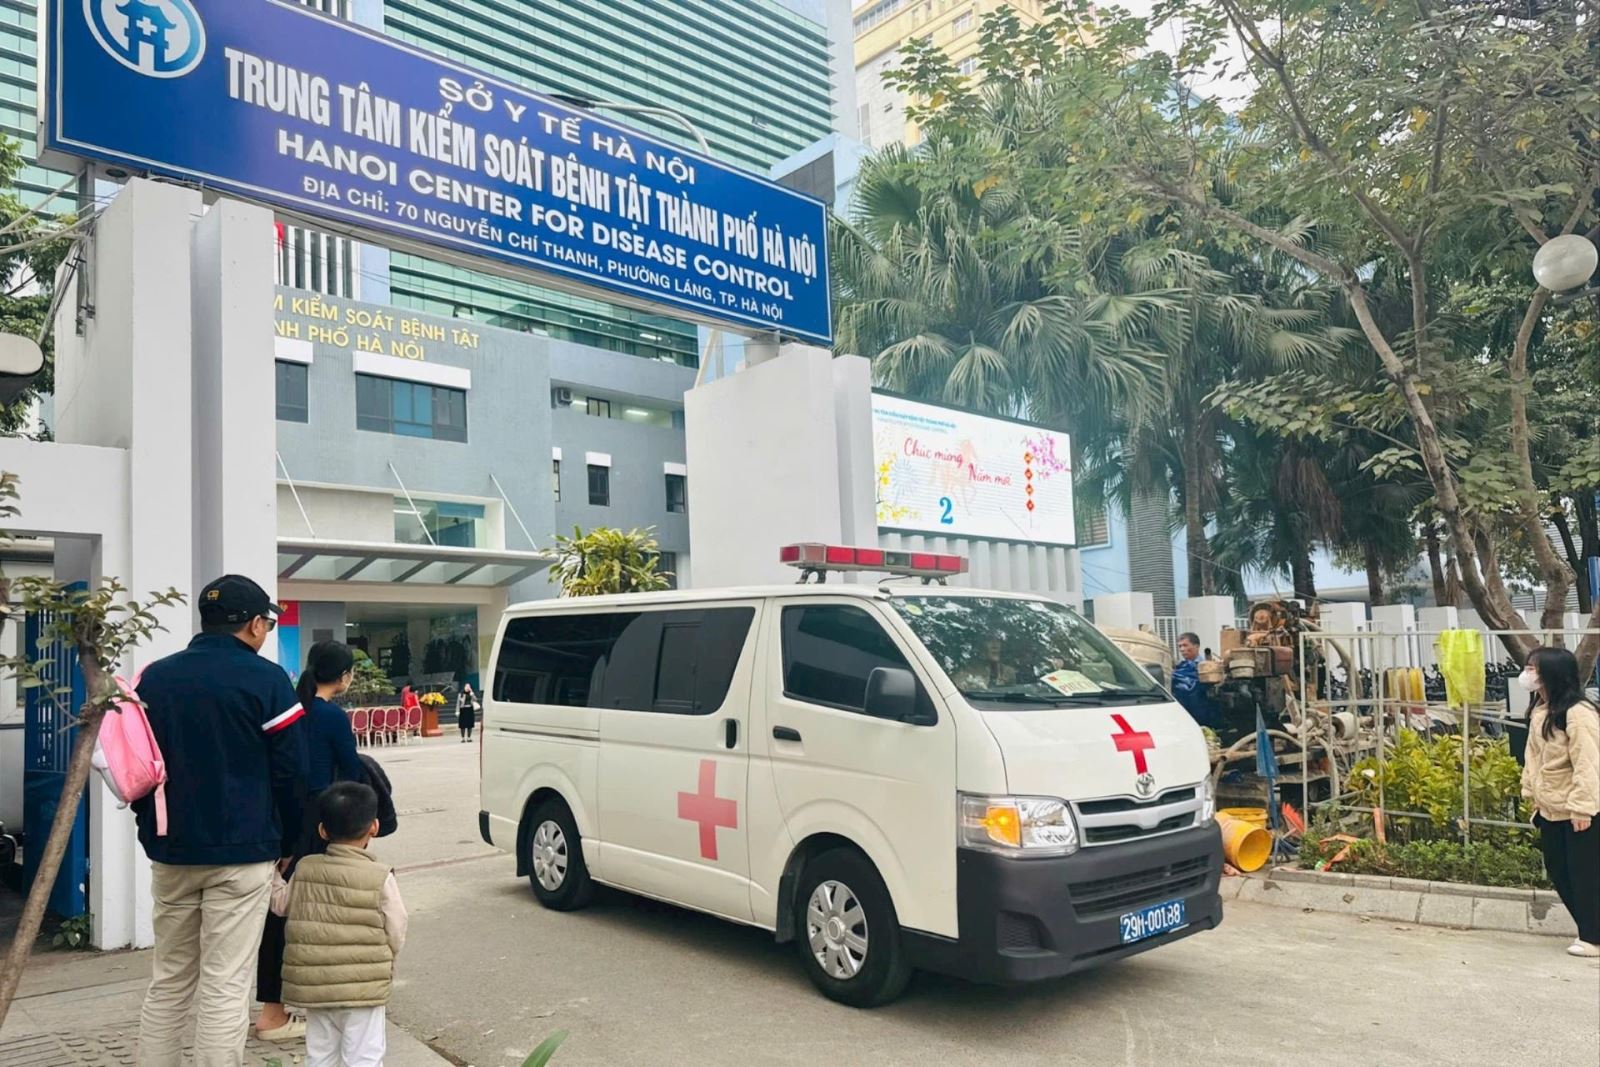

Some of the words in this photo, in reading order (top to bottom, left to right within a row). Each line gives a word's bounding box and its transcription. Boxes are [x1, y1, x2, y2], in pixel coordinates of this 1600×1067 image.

[224, 47, 330, 127] TRUNG
[338, 81, 401, 148] TÂM
[409, 102, 476, 171] KIỂM
[483, 136, 544, 192] SOÁT
[551, 152, 610, 212] BỆNH
[614, 173, 651, 230] TẬT
[656, 191, 719, 247] THÀNH
[723, 210, 758, 260] PHỐ
[762, 224, 786, 269] HÀ
[789, 233, 817, 284] NỘI
[439, 77, 493, 111] SỞ
[504, 99, 527, 123] Y
[538, 112, 582, 144] TẾ
[593, 132, 637, 164] HÀ
[646, 151, 695, 185] NỘI
[278, 128, 398, 187] HANOI
[409, 169, 522, 222] CENTER
[531, 204, 584, 240] FOR
[592, 221, 687, 270] DISEASE
[694, 254, 794, 301] CONTROL
[303, 175, 340, 201] ĐỊA
[347, 189, 389, 213] CHỈ:
[396, 201, 418, 220] 70
[424, 218, 502, 243] NGUYỄN
[508, 231, 538, 252] CHÍ
[542, 240, 603, 273] THANH,
[607, 259, 671, 289] PHƯỜNG
[674, 279, 716, 305] LÁNG,
[719, 291, 738, 308] TP.
[741, 297, 759, 314] HÀ
[762, 303, 783, 321] NỘI
[292, 294, 338, 321] KIỂM
[345, 308, 394, 331] SOÁT
[401, 318, 445, 341] BỆNH
[451, 327, 480, 350] TẬT
[308, 325, 349, 347] PHỐ
[357, 333, 384, 354] HÀ
[904, 437, 931, 459] Chúc
[939, 496, 954, 525] 2
